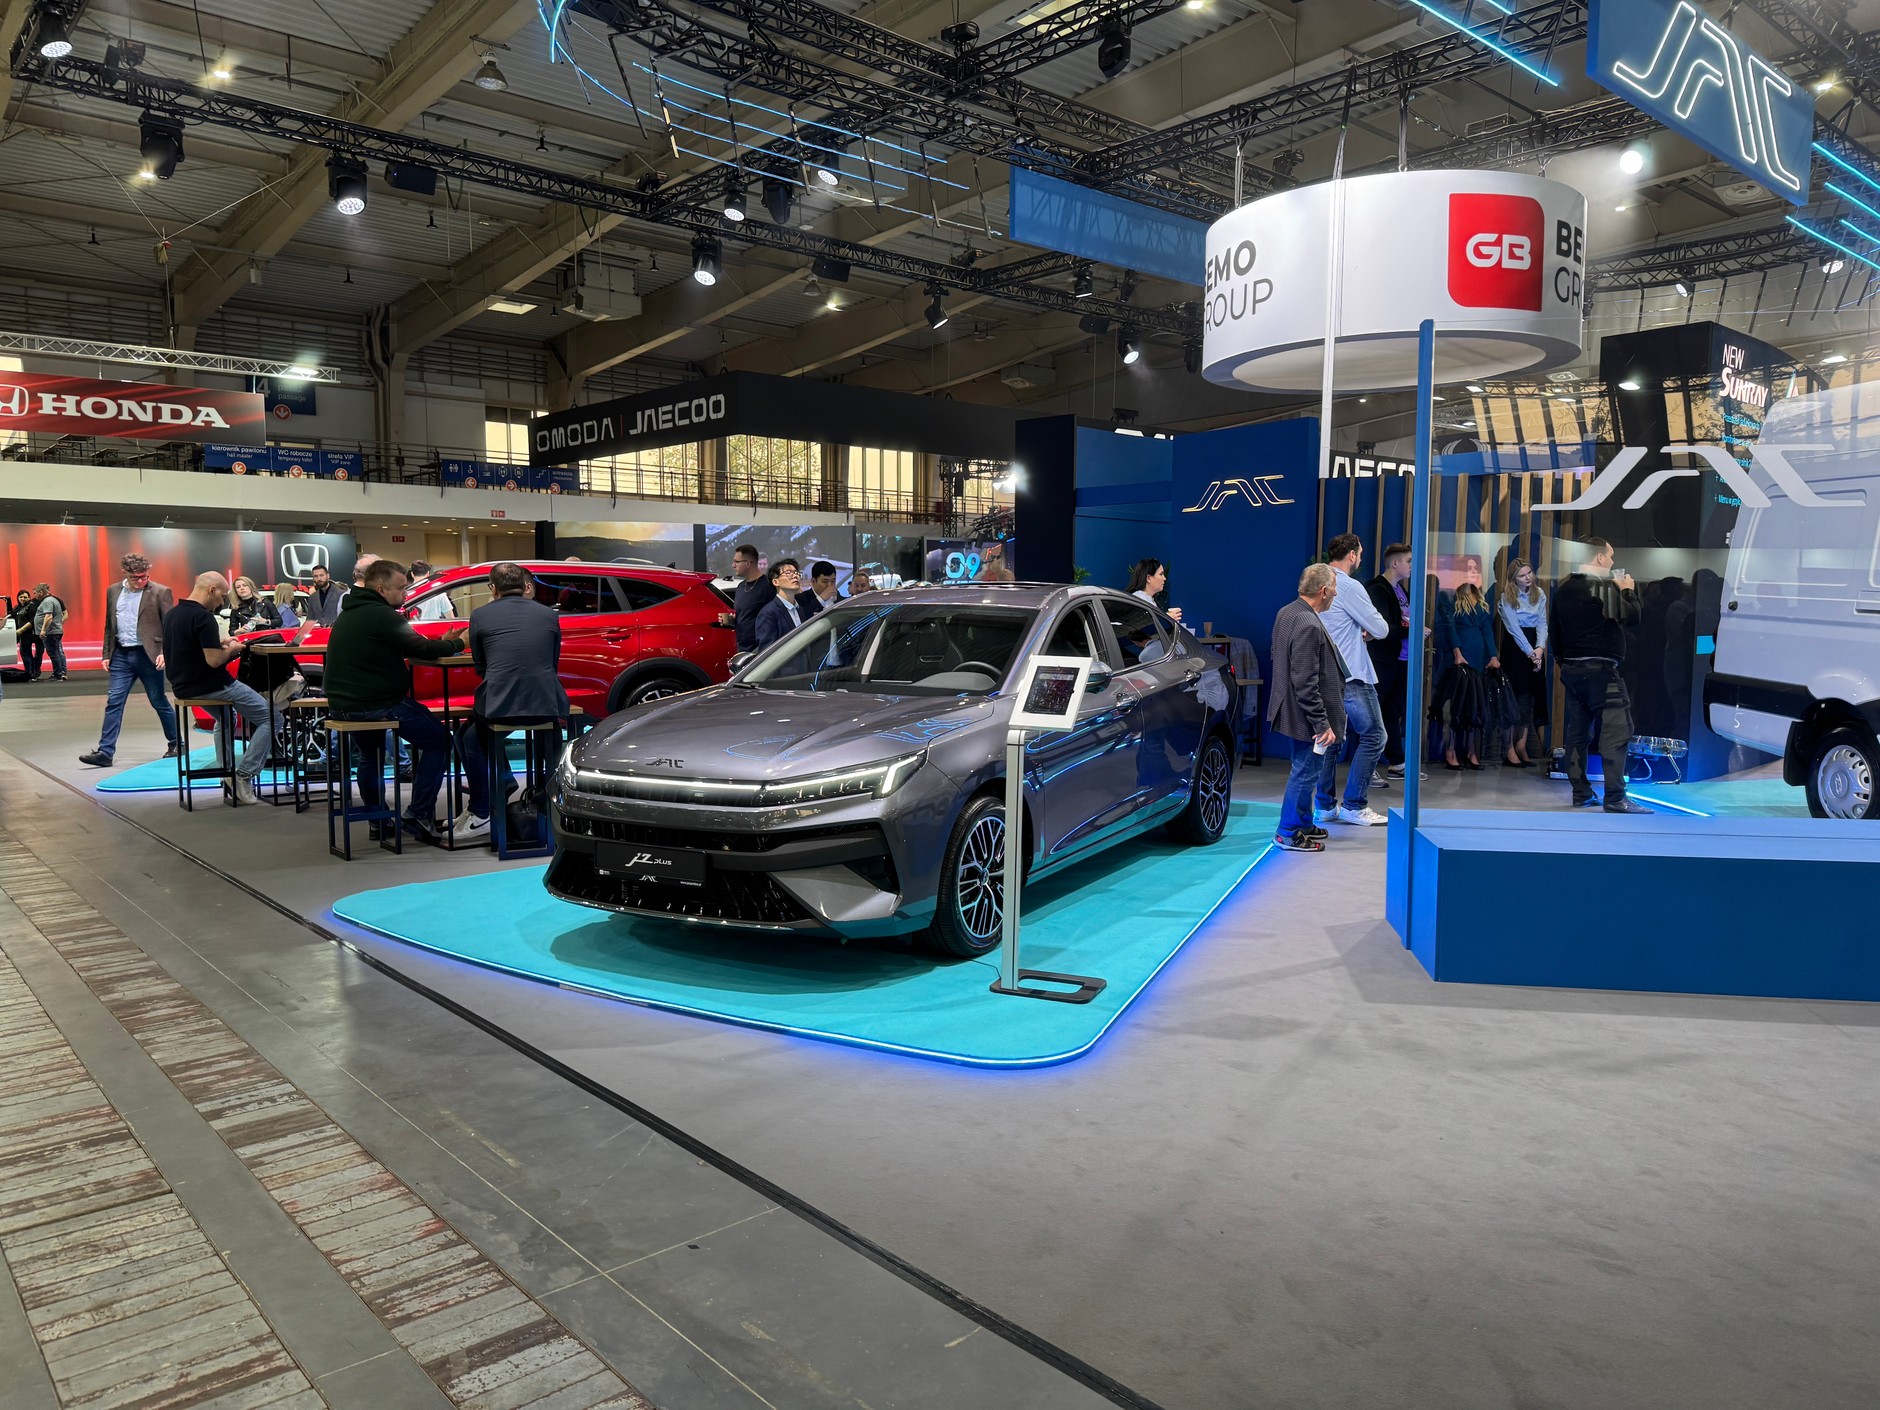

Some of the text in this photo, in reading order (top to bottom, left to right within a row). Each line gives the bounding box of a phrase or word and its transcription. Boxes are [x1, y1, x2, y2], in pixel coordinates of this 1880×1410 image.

[1613, 1, 1800, 190] JAC
[1466, 233, 1532, 270] GB
[1556, 219, 1583, 266] BE
[1206, 240, 1257, 294] EMO
[1554, 266, 1581, 309] GR
[1206, 278, 1274, 334] ROUP
[1722, 343, 1745, 370] NEW
[37, 392, 231, 429] HONDA
[536, 393, 726, 453] OMODA JAECOO
[1182, 474, 1295, 512] JAC
[1530, 445, 1867, 510] JAC
